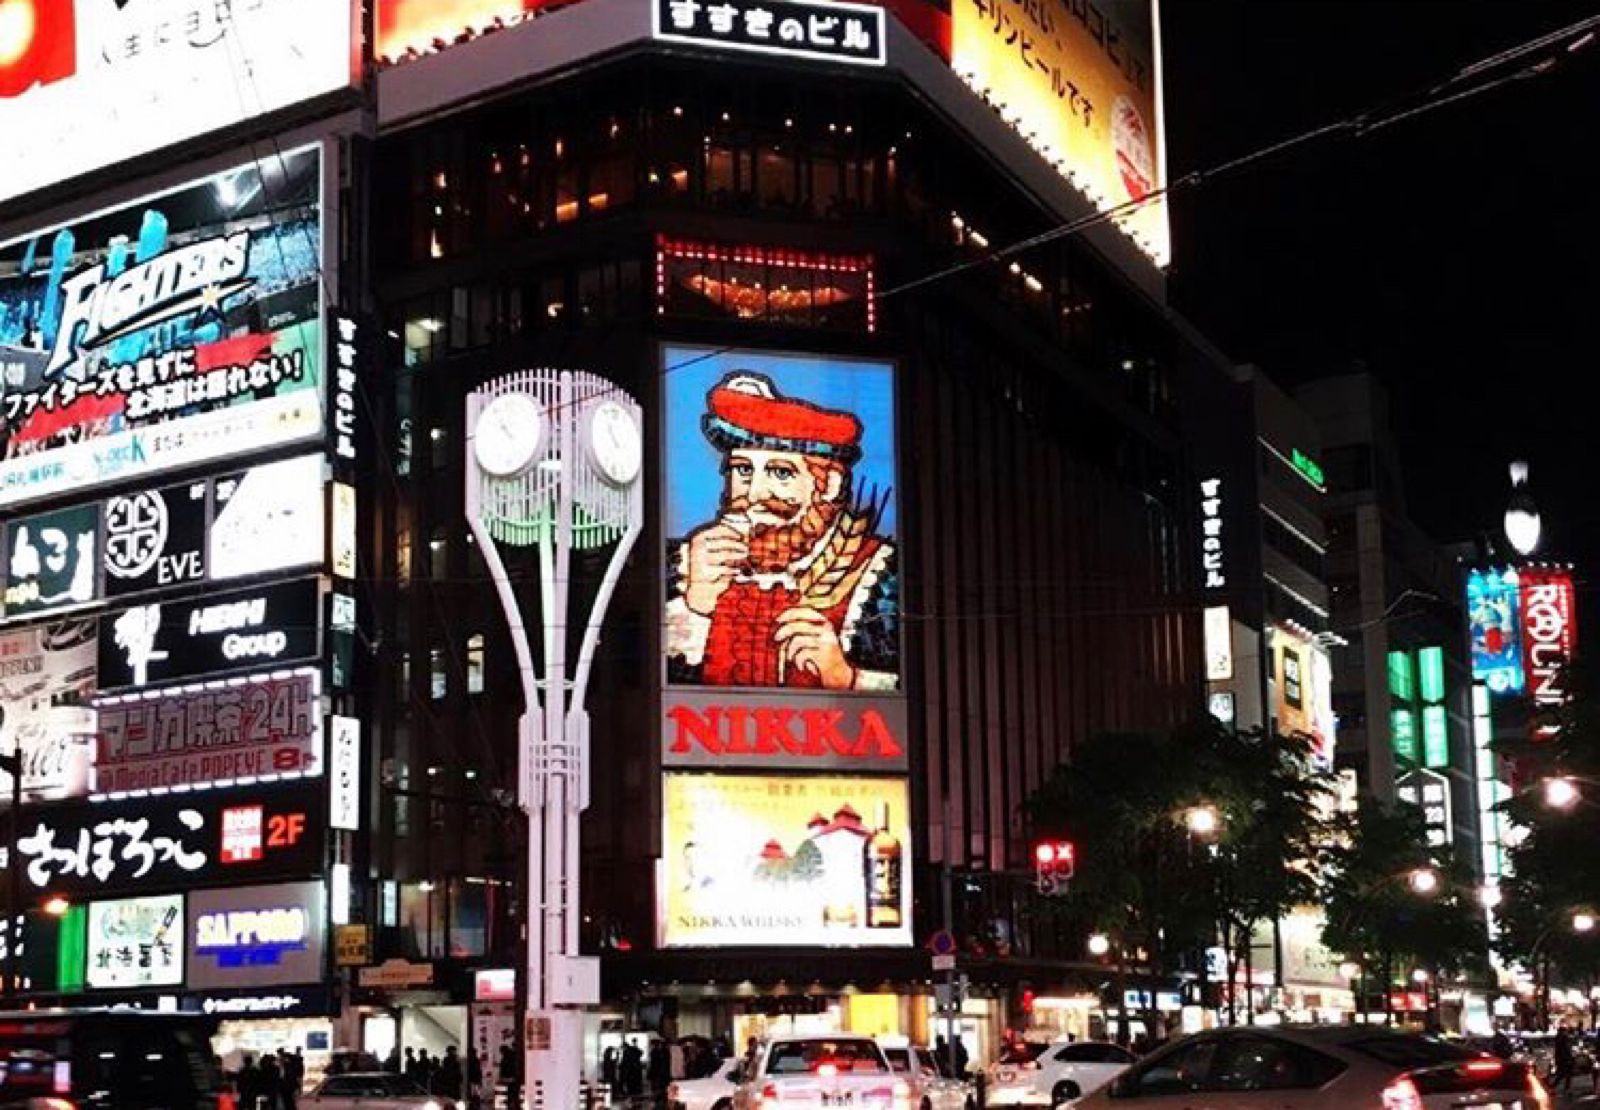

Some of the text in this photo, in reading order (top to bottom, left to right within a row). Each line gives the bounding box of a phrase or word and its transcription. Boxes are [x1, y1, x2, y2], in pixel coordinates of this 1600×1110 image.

[668, 0, 871, 50] すすきのビル
[46, 231, 249, 377] FIGHTERS
[337, 317, 357, 458] すすきのビル
[1201, 478, 1225, 588] すすきのビル
[157, 550, 204, 584] EVE
[250, 683, 315, 742] 24H
[666, 704, 903, 758] NIKKA
[16, 809, 208, 887] さっぽろっこ
[266, 813, 306, 846] 2F
[195, 907, 305, 947] SAPPORO
[678, 915, 738, 929] NIKKA
